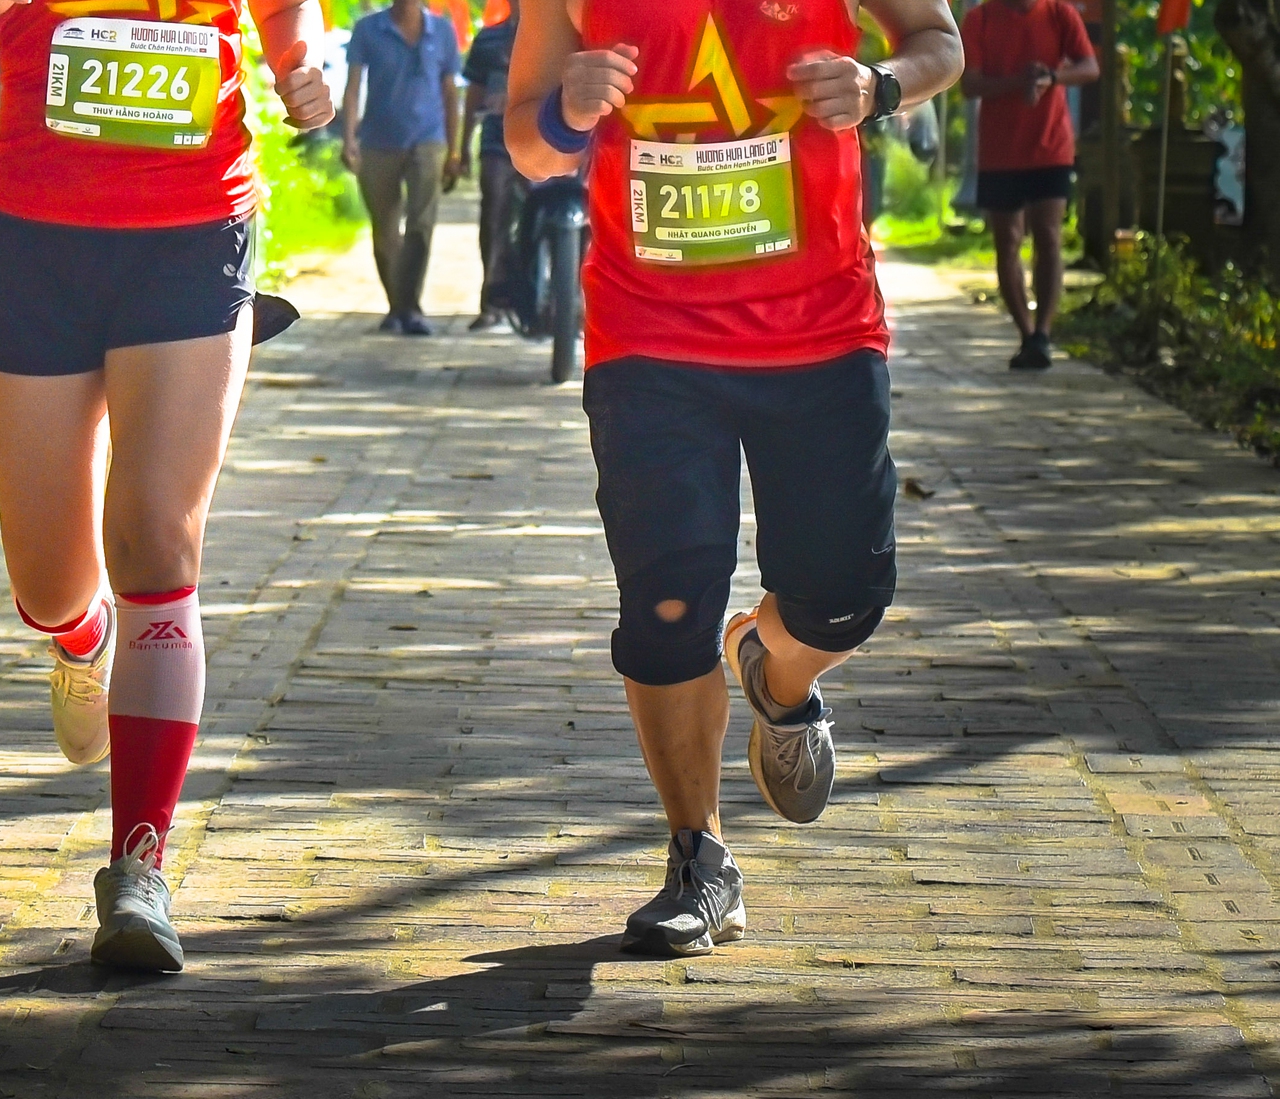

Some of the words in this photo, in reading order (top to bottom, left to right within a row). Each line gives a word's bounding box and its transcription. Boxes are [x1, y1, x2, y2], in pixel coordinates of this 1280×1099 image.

[91, 29, 117, 40] HCR
[51, 63, 65, 97] 21KM
[80, 59, 190, 101] 21226
[660, 153, 683, 165] HCR
[633, 189, 645, 223] 21KM
[659, 179, 761, 219] 21178
[691, 230, 722, 238] QUANG
[129, 640, 193, 650] Bantuman
